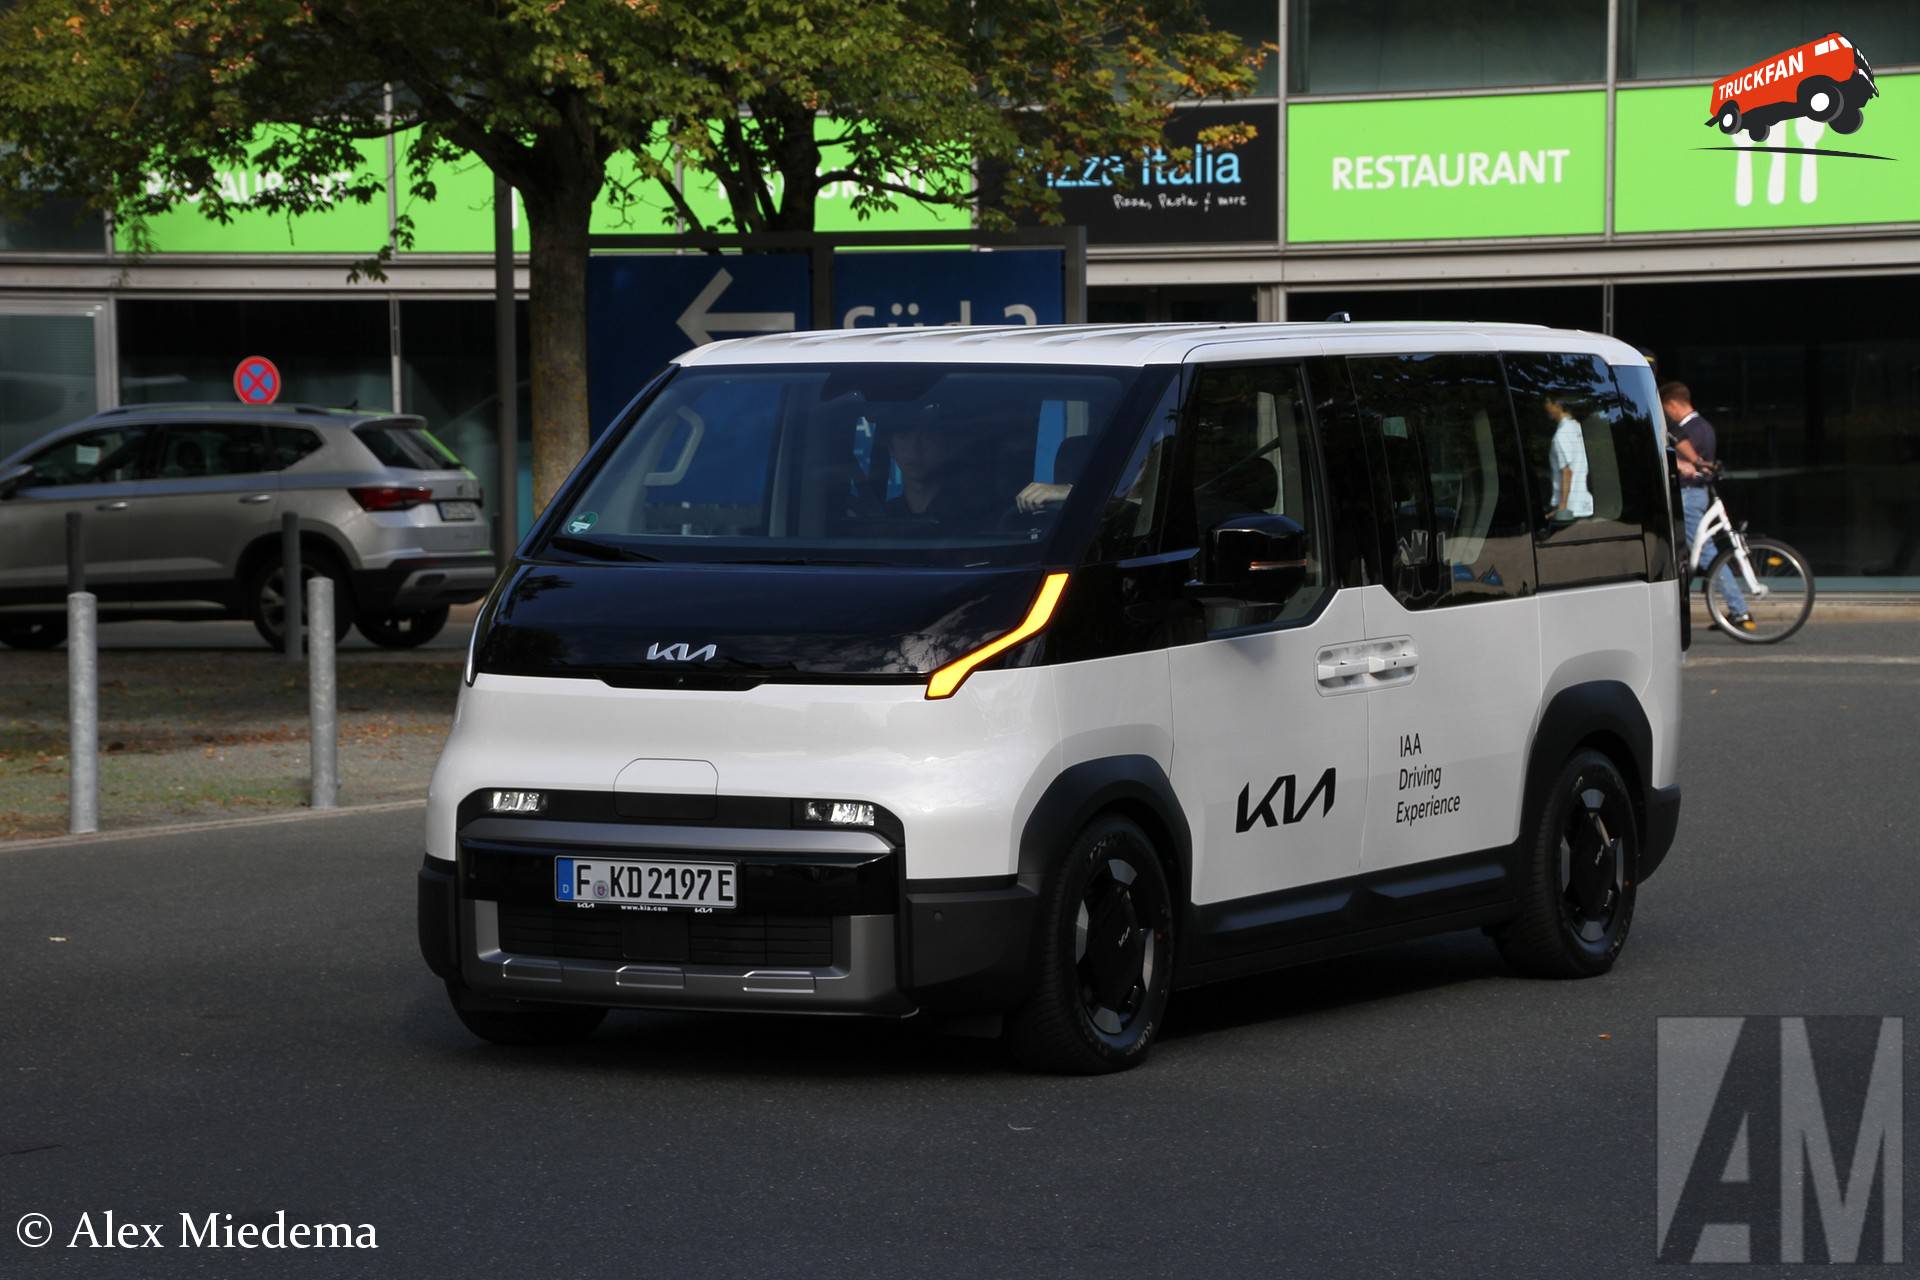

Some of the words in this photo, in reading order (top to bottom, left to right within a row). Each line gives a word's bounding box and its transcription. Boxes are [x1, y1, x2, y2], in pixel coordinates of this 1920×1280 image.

[1332, 149, 1571, 191] RESTAURANT
[1217, 195, 1247, 206] more
[646, 641, 717, 662] KIA
[1400, 733, 1422, 758] IAA
[1399, 764, 1442, 791] Driving
[1235, 767, 1337, 834] KIA
[1395, 795, 1461, 827] Experience
[620, 904, 669, 912] www.kia.com
